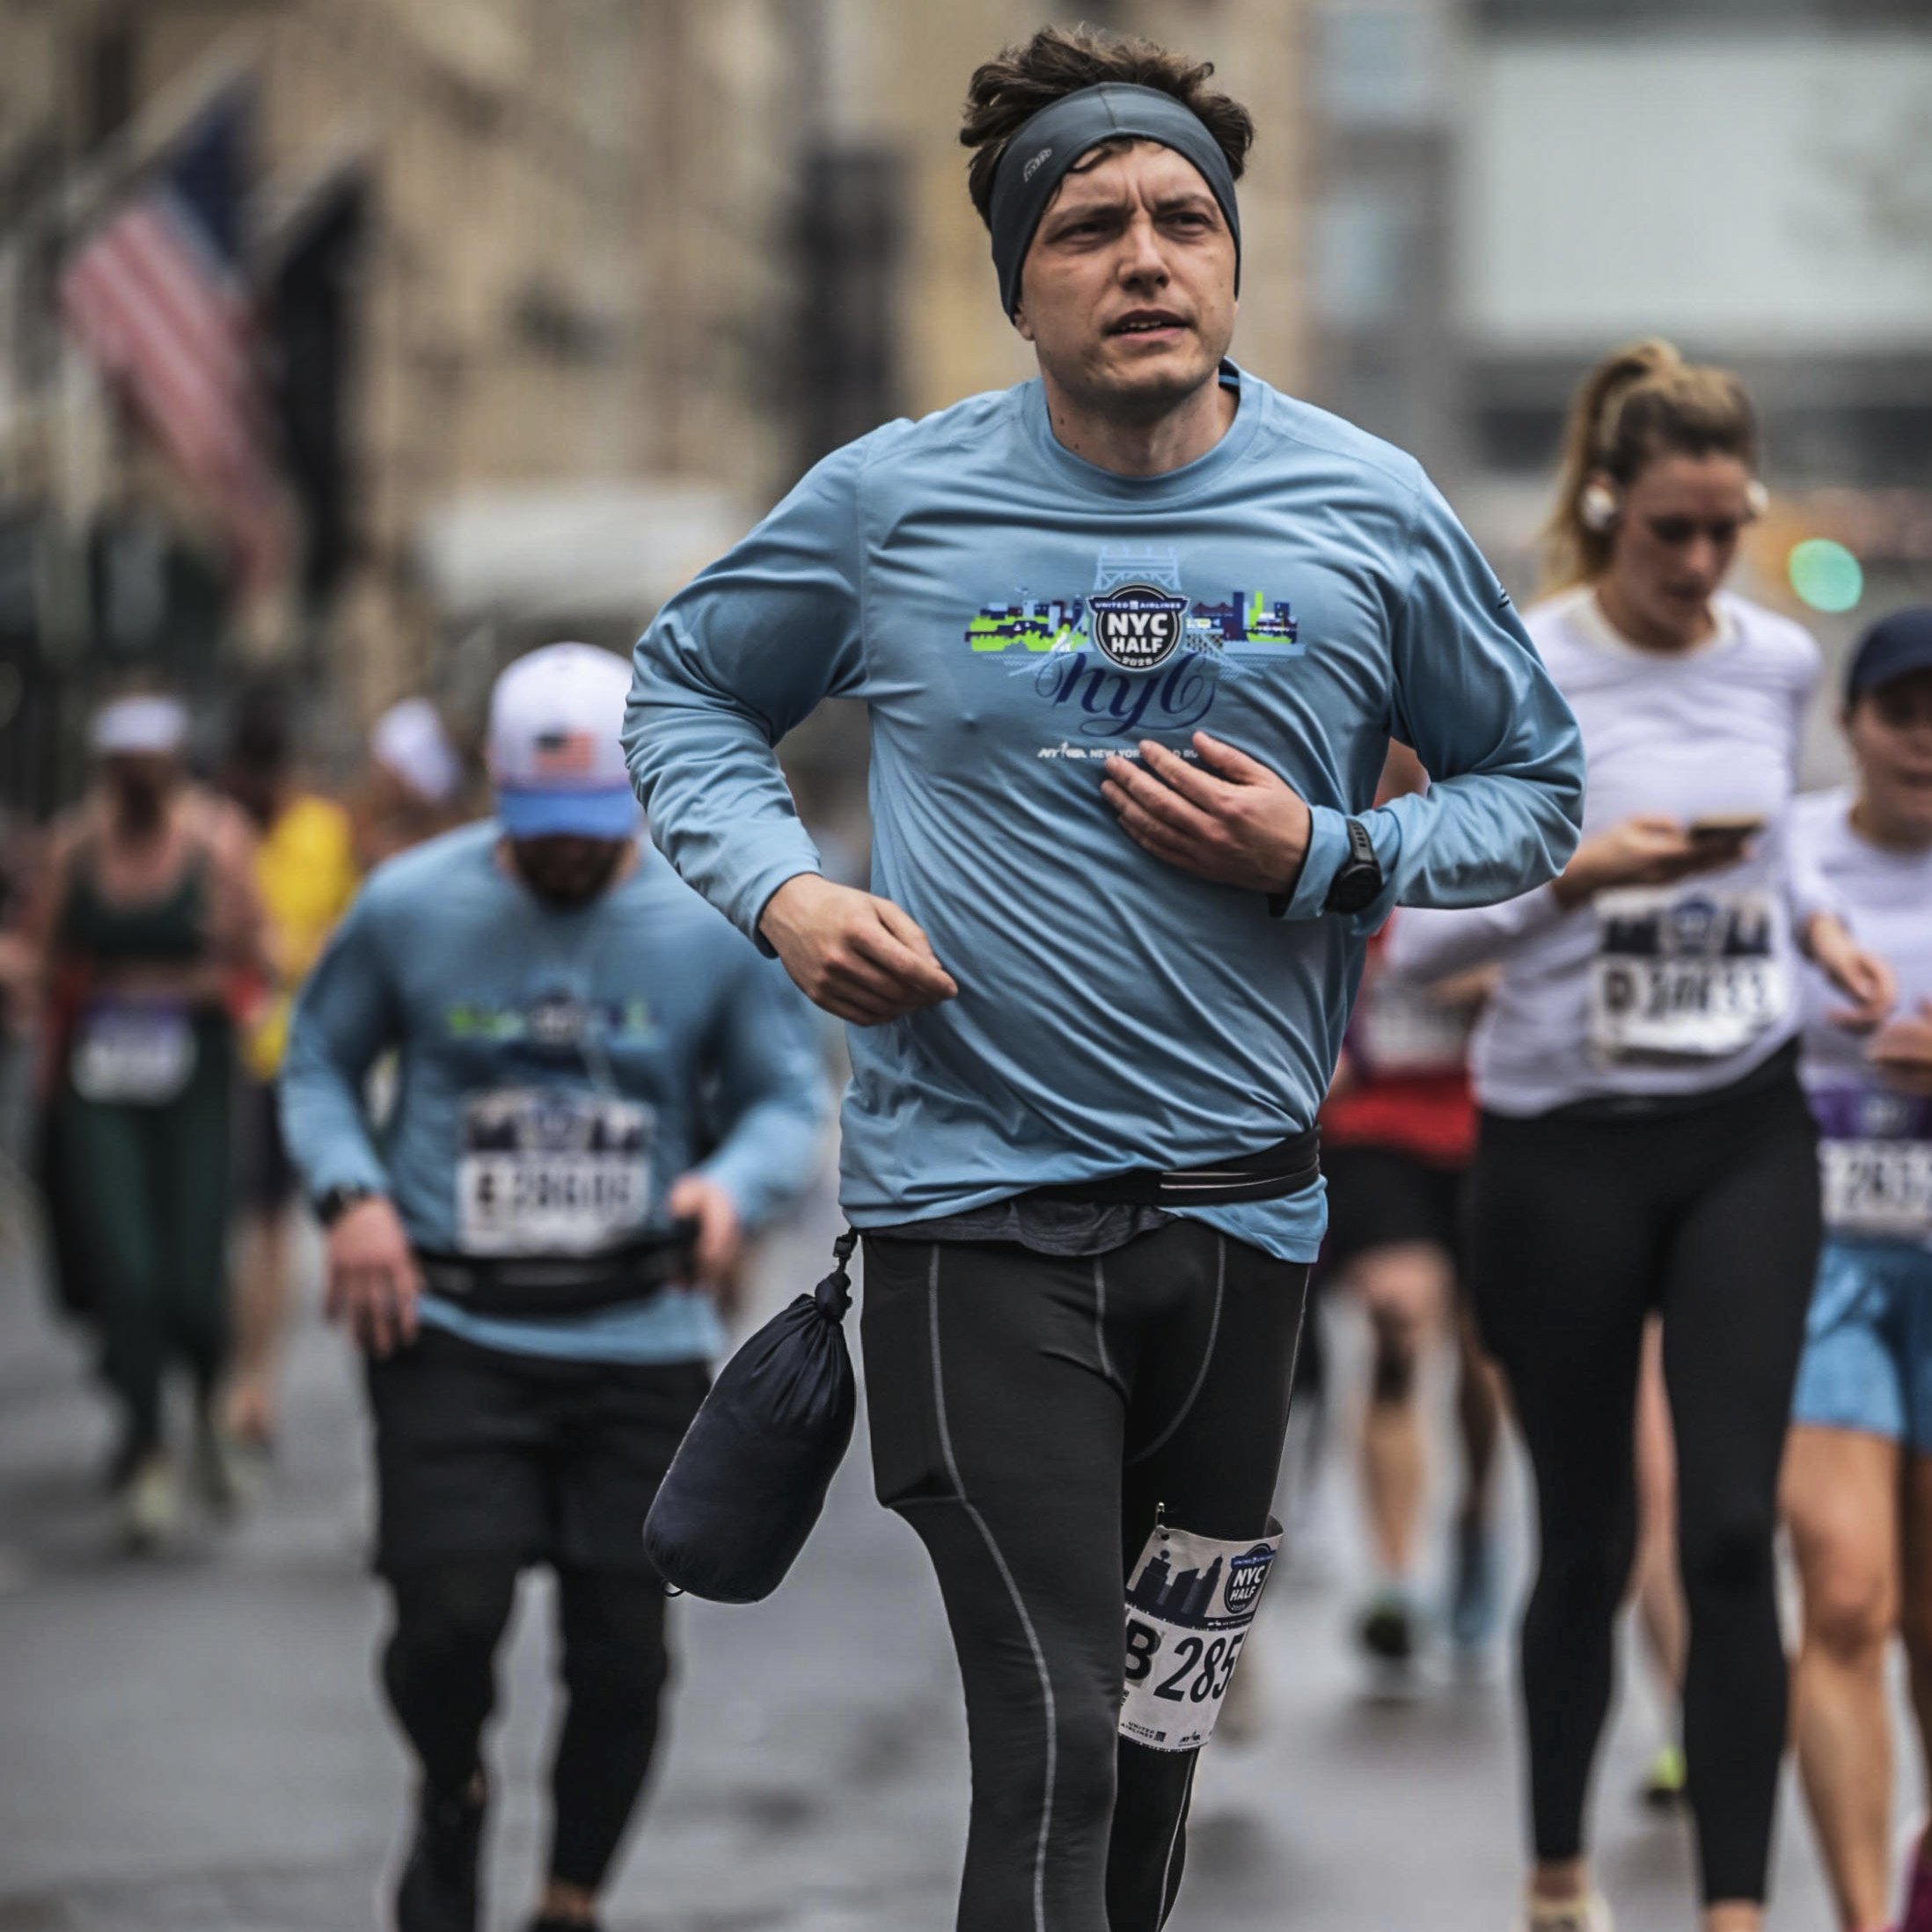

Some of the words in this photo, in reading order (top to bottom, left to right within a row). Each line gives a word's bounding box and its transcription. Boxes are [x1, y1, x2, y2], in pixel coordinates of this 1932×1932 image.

[1107, 612, 1168, 636] NYC
[1111, 636, 1164, 653] HALF
[1117, 749, 1141, 758] YOR
[1233, 1565, 1266, 1587] NYC
[1229, 1585, 1256, 1601] HALF
[1124, 1618, 1162, 1680] B
